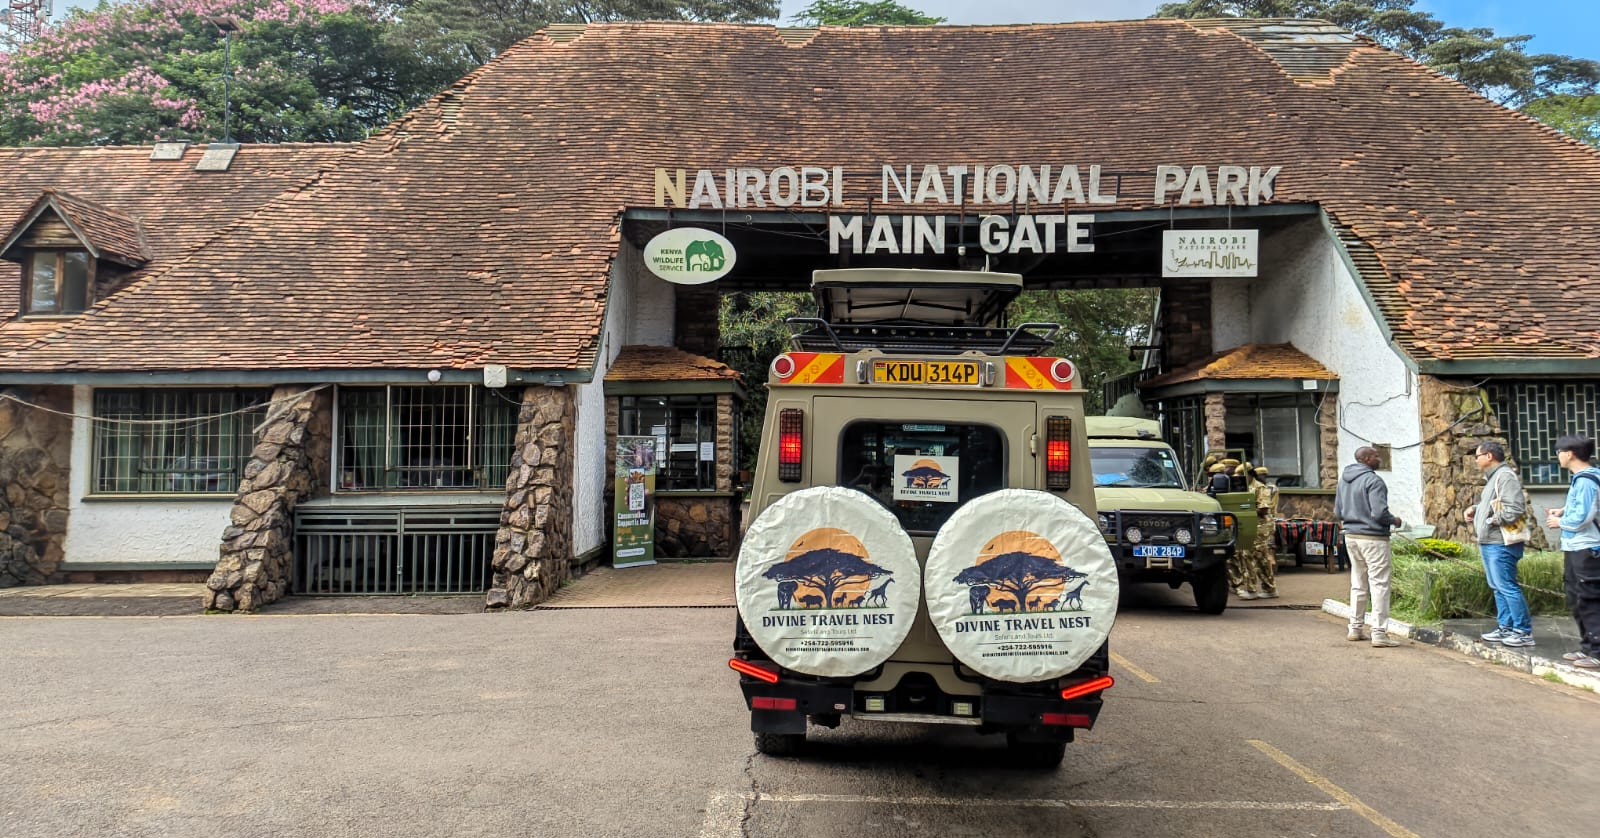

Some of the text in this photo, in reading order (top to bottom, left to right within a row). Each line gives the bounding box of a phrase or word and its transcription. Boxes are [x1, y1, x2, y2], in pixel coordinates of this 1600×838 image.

[654, 164, 1282, 209] NAIROBI NATIONAL PARK
[829, 214, 1095, 254] MAIN GATE
[1178, 236, 1247, 244] NAIROBI
[652, 256, 684, 264] WILDLIFE
[886, 363, 975, 383] KDU 314P
[1142, 546, 1182, 557] KDR 284P
[762, 613, 896, 627] DIVINE TRAVEL NEST
[955, 616, 1092, 633] DIVINE TRAVEL NEST
